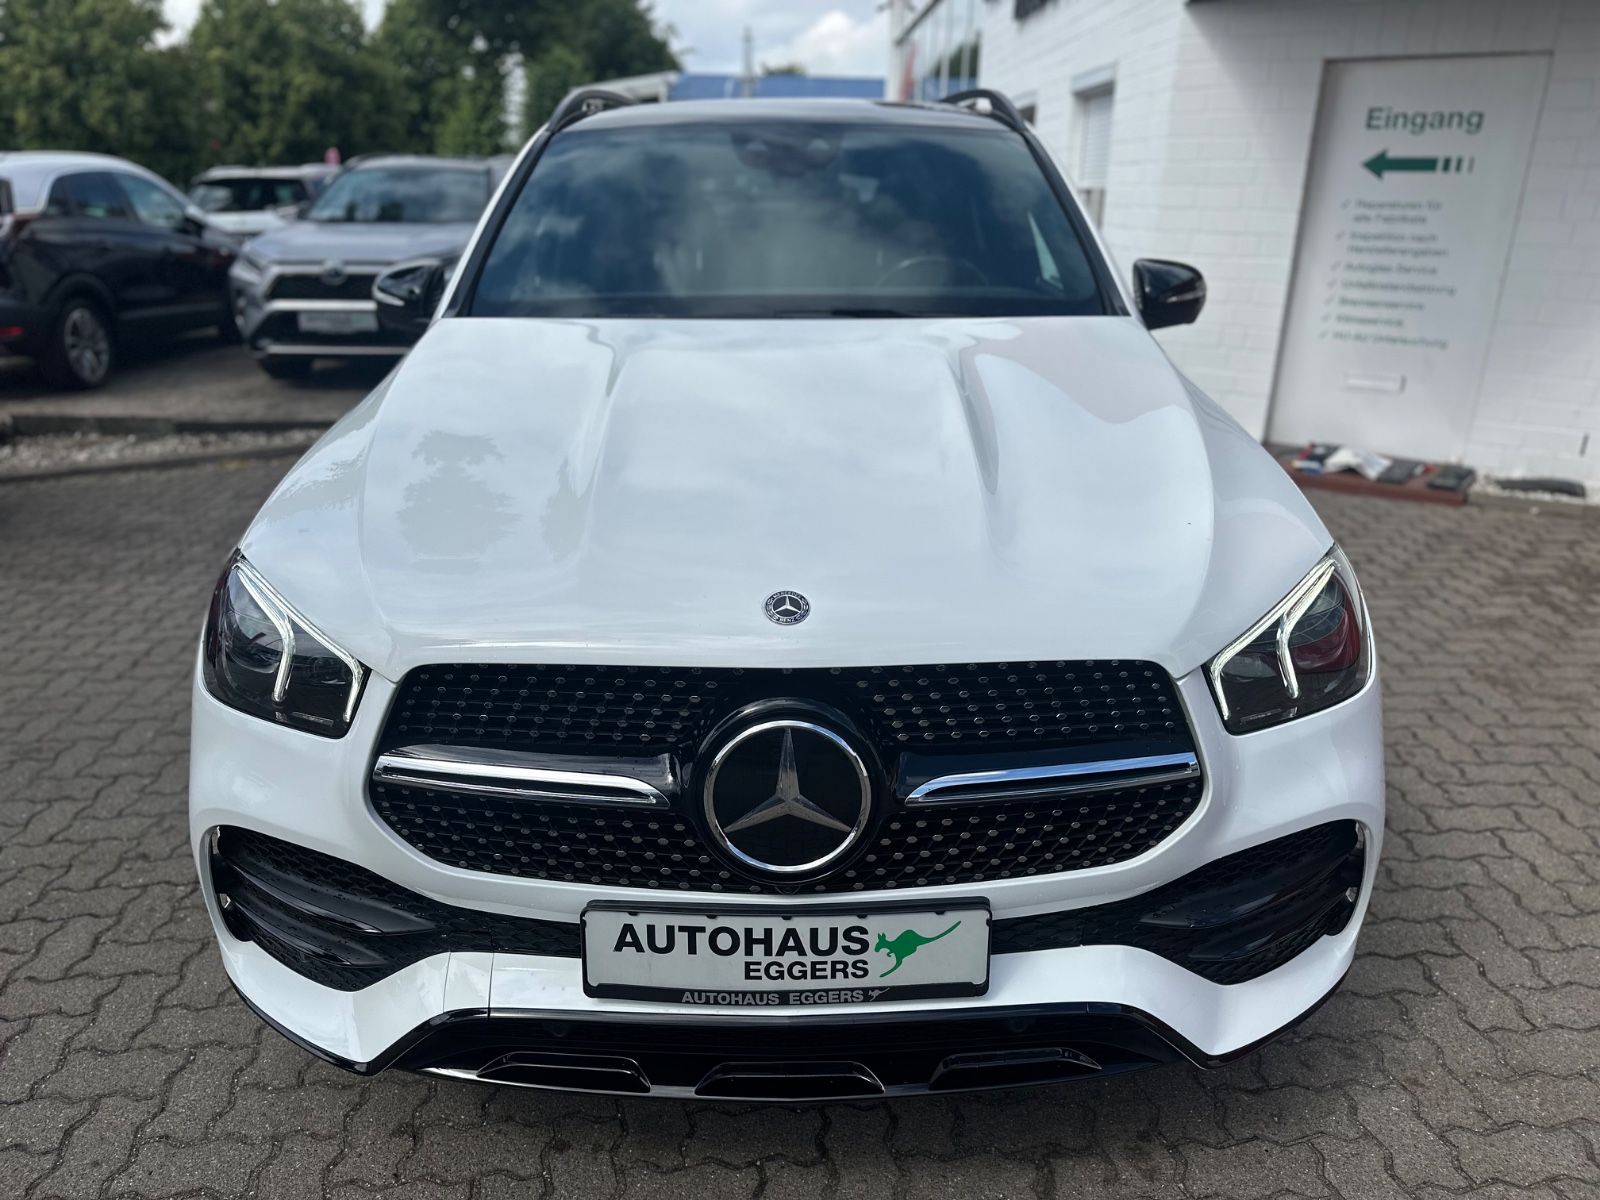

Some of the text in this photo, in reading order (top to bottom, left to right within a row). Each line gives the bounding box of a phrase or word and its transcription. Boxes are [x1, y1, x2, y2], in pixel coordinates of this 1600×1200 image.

[1365, 106, 1485, 135] Eingang
[613, 922, 870, 957] AUTOHAUS
[744, 959, 869, 981] EGGERS
[681, 989, 864, 1006] AUTOHAUS EGGERS
